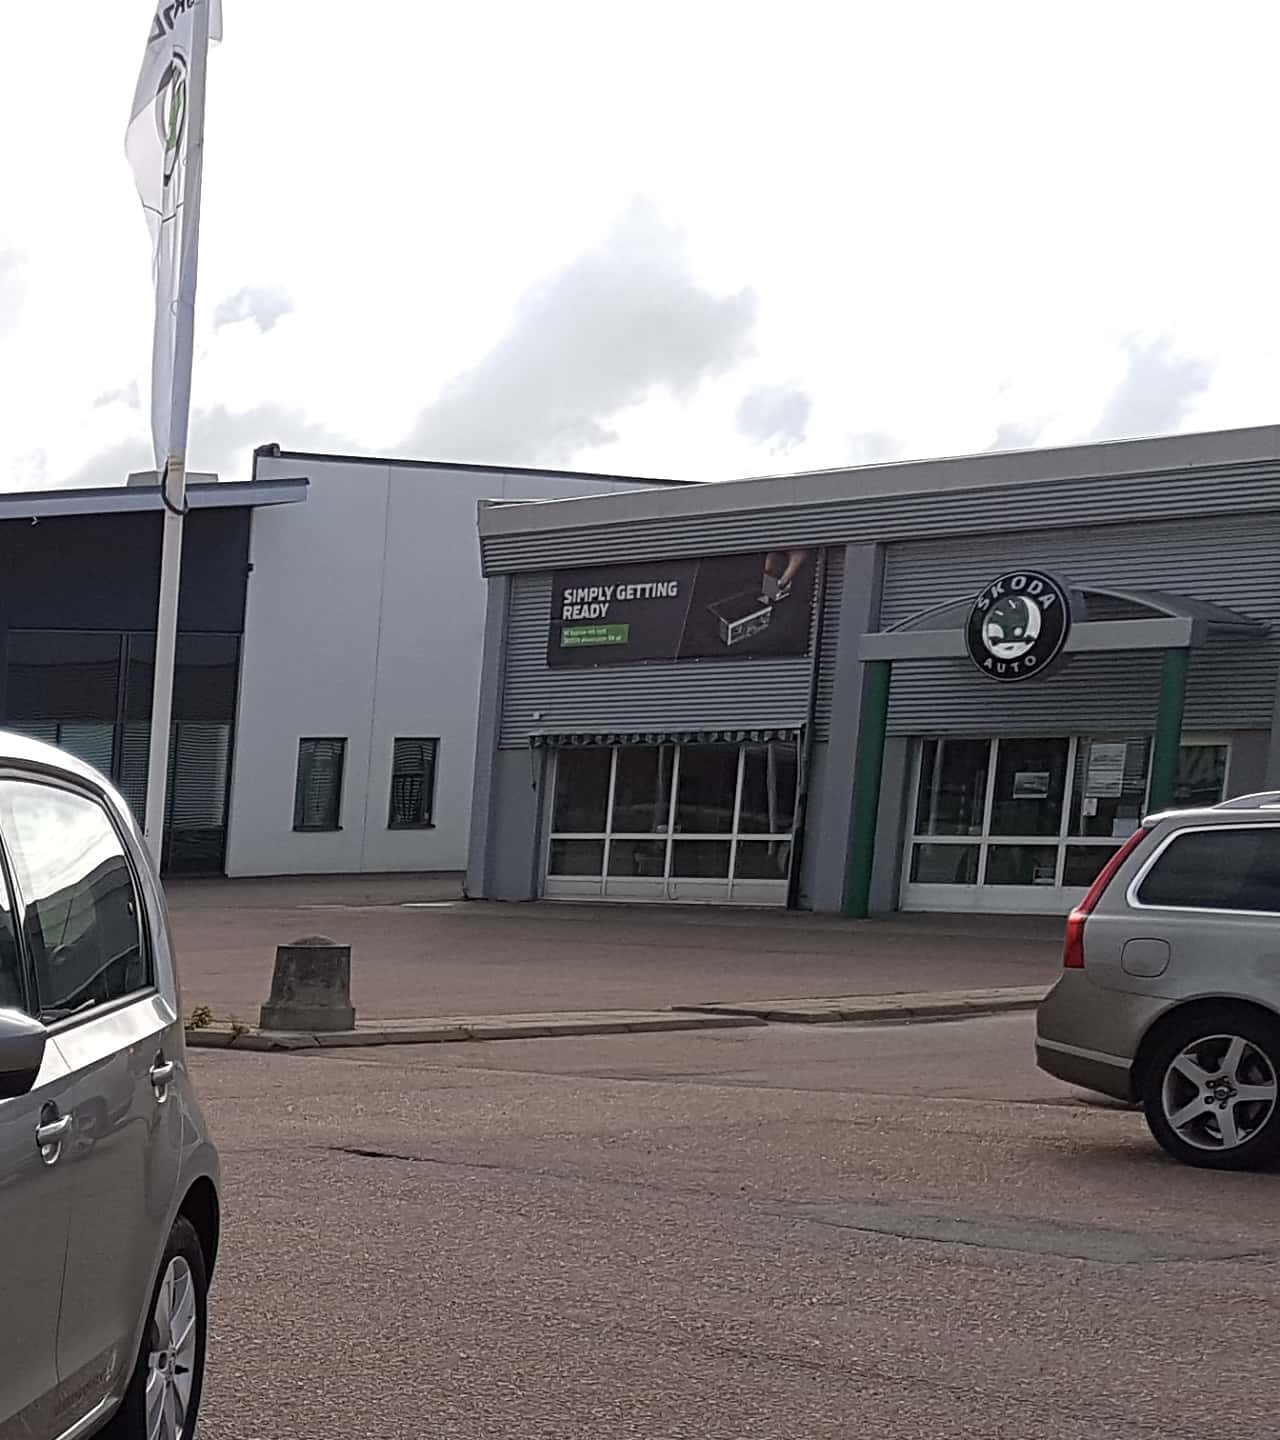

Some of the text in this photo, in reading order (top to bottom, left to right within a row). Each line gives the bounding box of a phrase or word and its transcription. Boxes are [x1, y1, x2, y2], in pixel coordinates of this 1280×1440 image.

[563, 581, 678, 604] SIMPLY GETTING
[562, 602, 609, 620] READY
[983, 658, 1037, 673] AUTO
